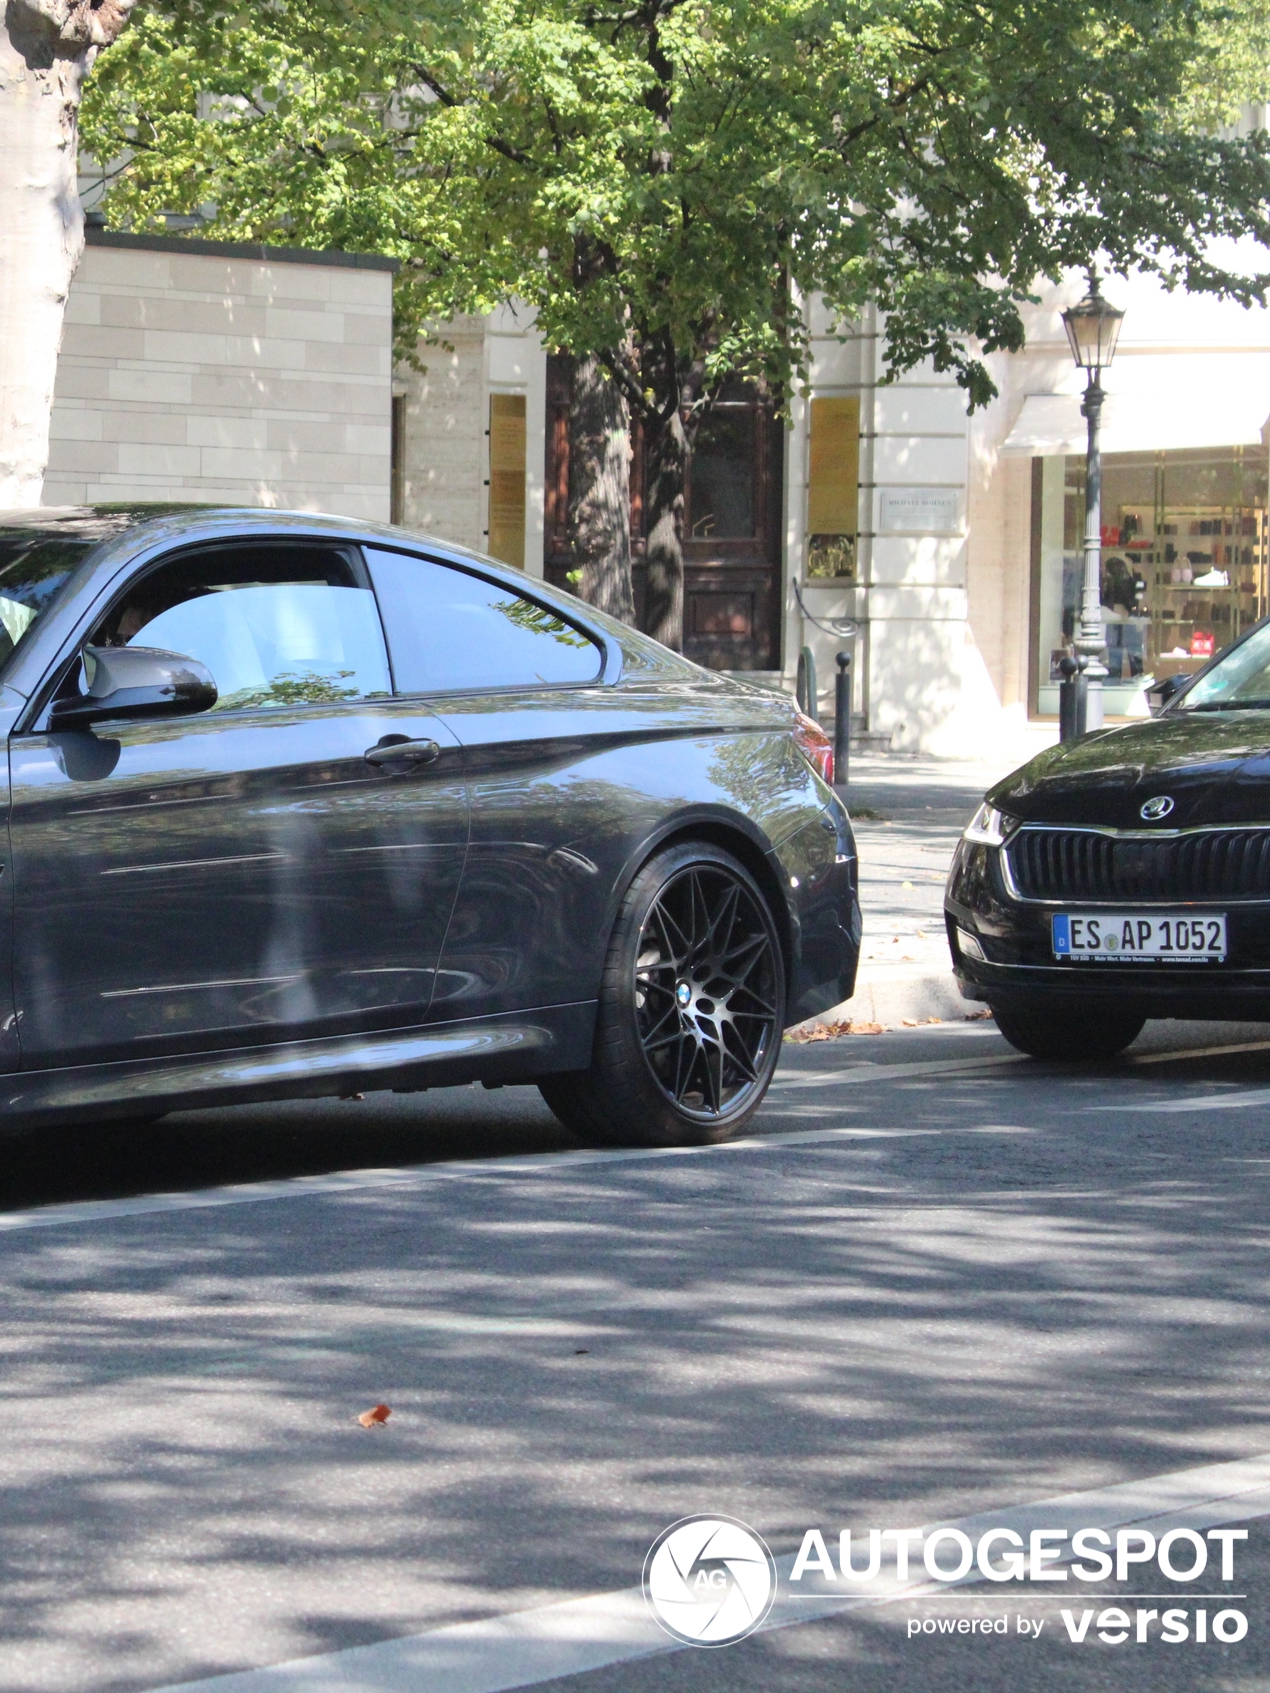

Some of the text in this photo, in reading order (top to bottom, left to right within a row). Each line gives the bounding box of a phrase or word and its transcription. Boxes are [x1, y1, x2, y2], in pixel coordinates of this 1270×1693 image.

[1058, 938, 1066, 947] D
[1070, 919, 1222, 951] ES AP 1052
